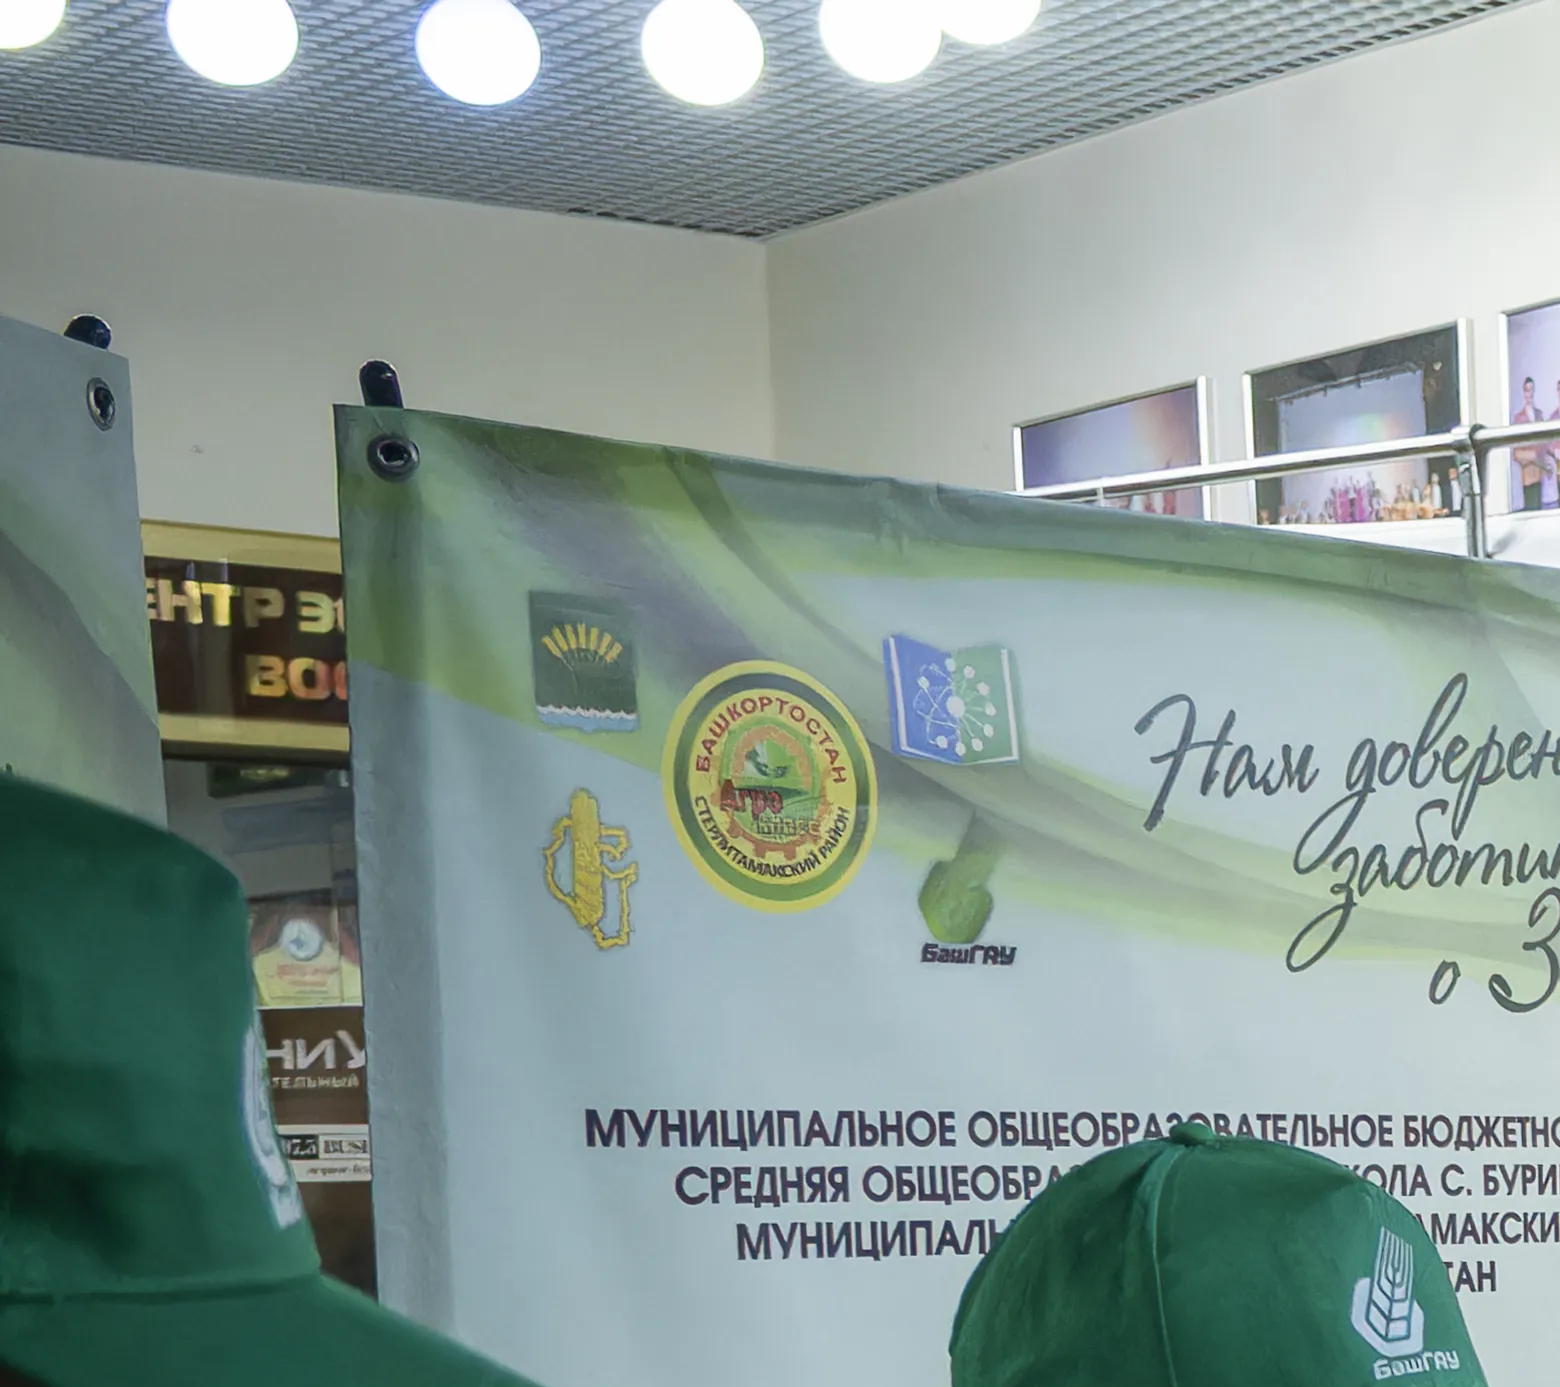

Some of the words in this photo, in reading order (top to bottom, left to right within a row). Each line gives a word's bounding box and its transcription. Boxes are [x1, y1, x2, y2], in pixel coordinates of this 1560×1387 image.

[145, 577, 241, 627] ЕНТР
[696, 696, 847, 783] БАШКОРТОСТАН
[1134, 693, 1319, 830] Нам
[695, 796, 821, 878] СТЕРЛИТАМАКСКИЙ
[820, 806, 851, 860] РАЙОН
[921, 943, 1017, 965] БашГАУ
[1428, 960, 1462, 1004] о
[585, 1108, 956, 1152] МУНИЦИПАЛЬНОЕ
[675, 1165, 850, 1208] СРЕДНЯЯ
[1373, 1349, 1460, 1381] БашГАУ
